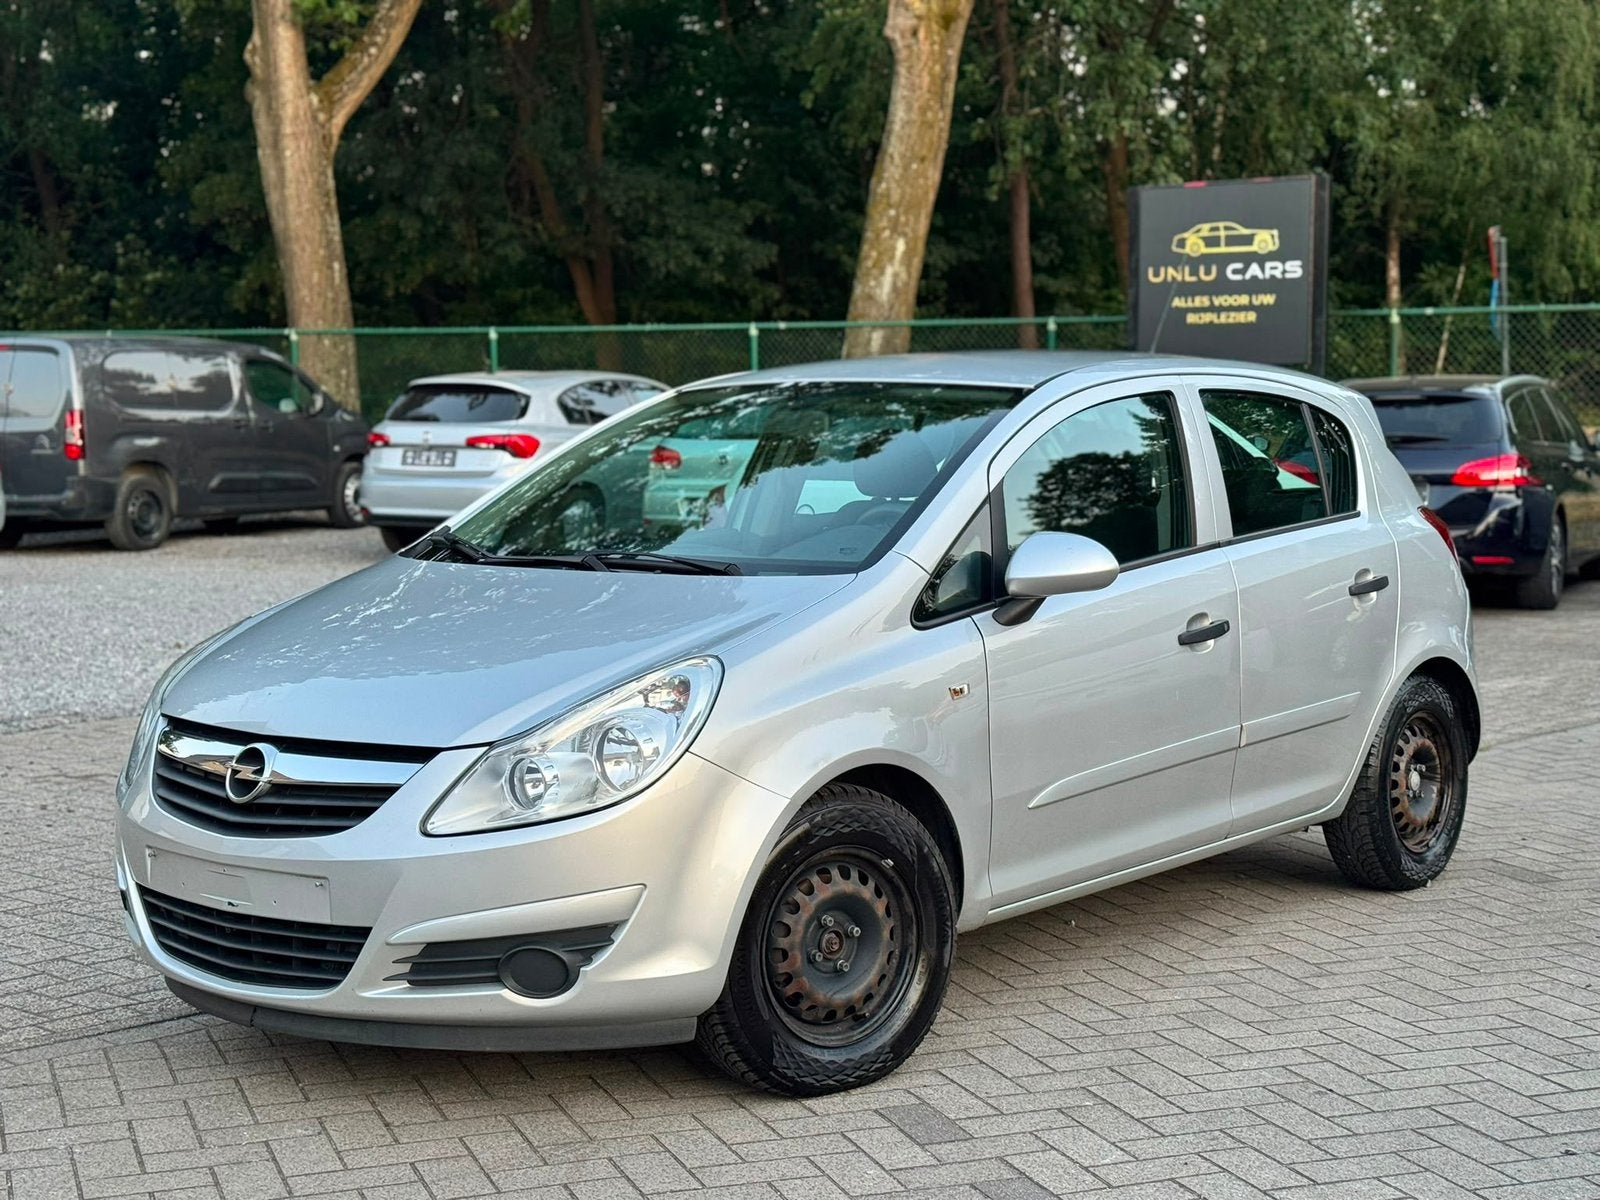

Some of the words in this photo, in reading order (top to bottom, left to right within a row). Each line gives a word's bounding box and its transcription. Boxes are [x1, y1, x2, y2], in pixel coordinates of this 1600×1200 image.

[1147, 265, 1217, 283] UNLU
[1226, 260, 1303, 280] CARS
[1171, 295, 1210, 308] ALLES
[1213, 294, 1250, 307] VOOR
[1253, 293, 1276, 305] UW
